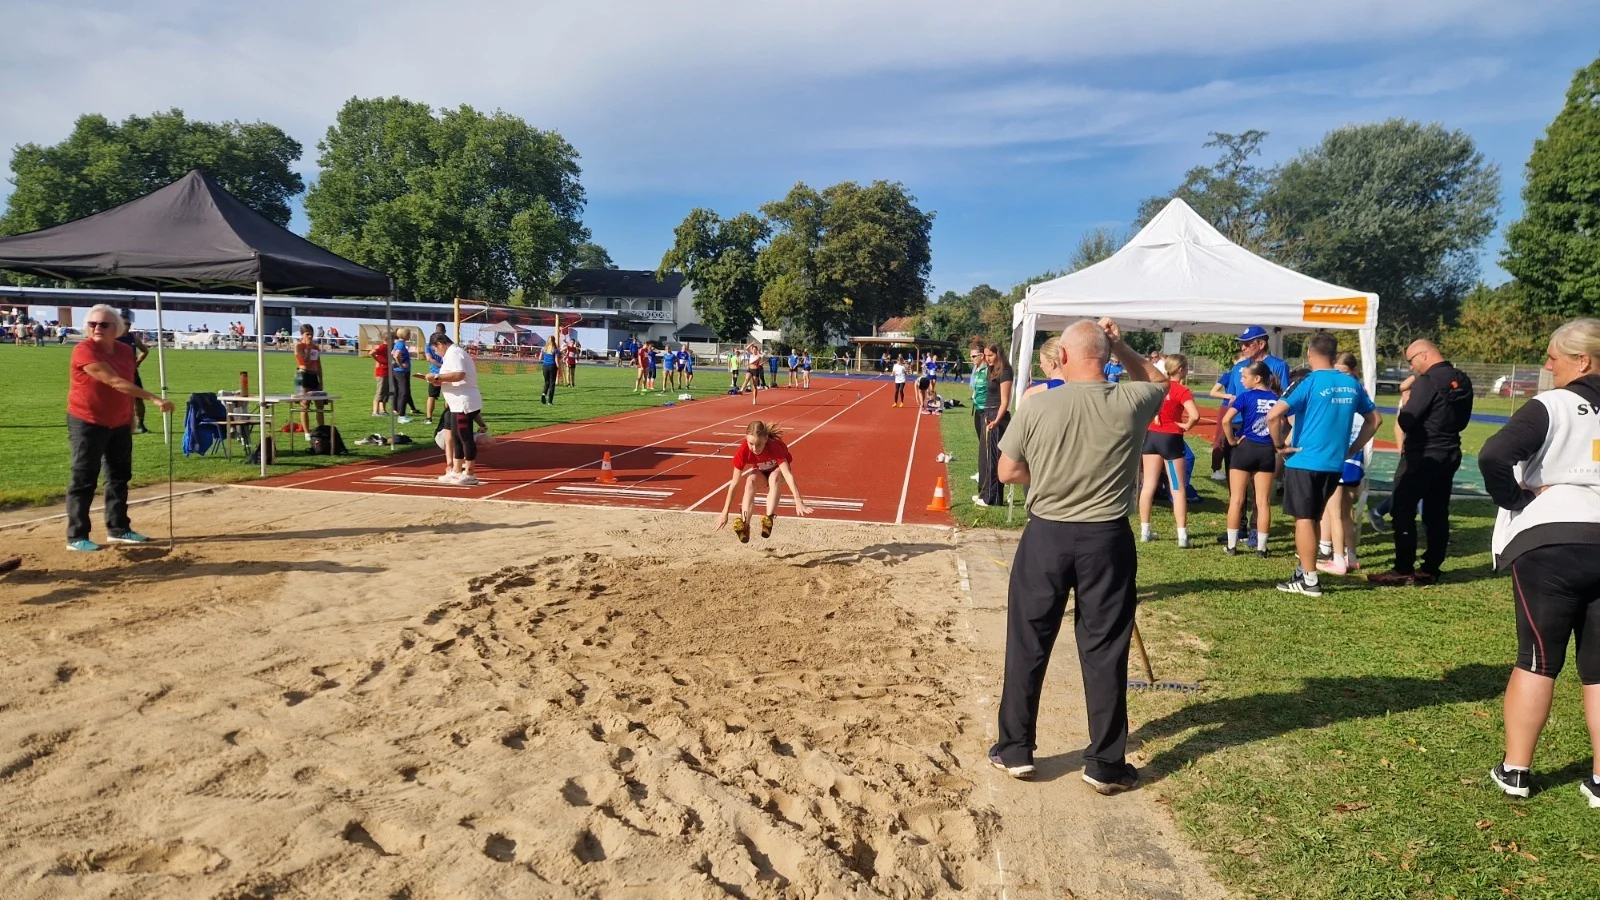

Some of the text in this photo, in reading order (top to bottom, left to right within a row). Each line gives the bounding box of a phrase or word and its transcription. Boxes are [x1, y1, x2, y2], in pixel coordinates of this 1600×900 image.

[1310, 303, 1359, 315] STIHL
[1319, 386, 1359, 397] VC FORTUN
